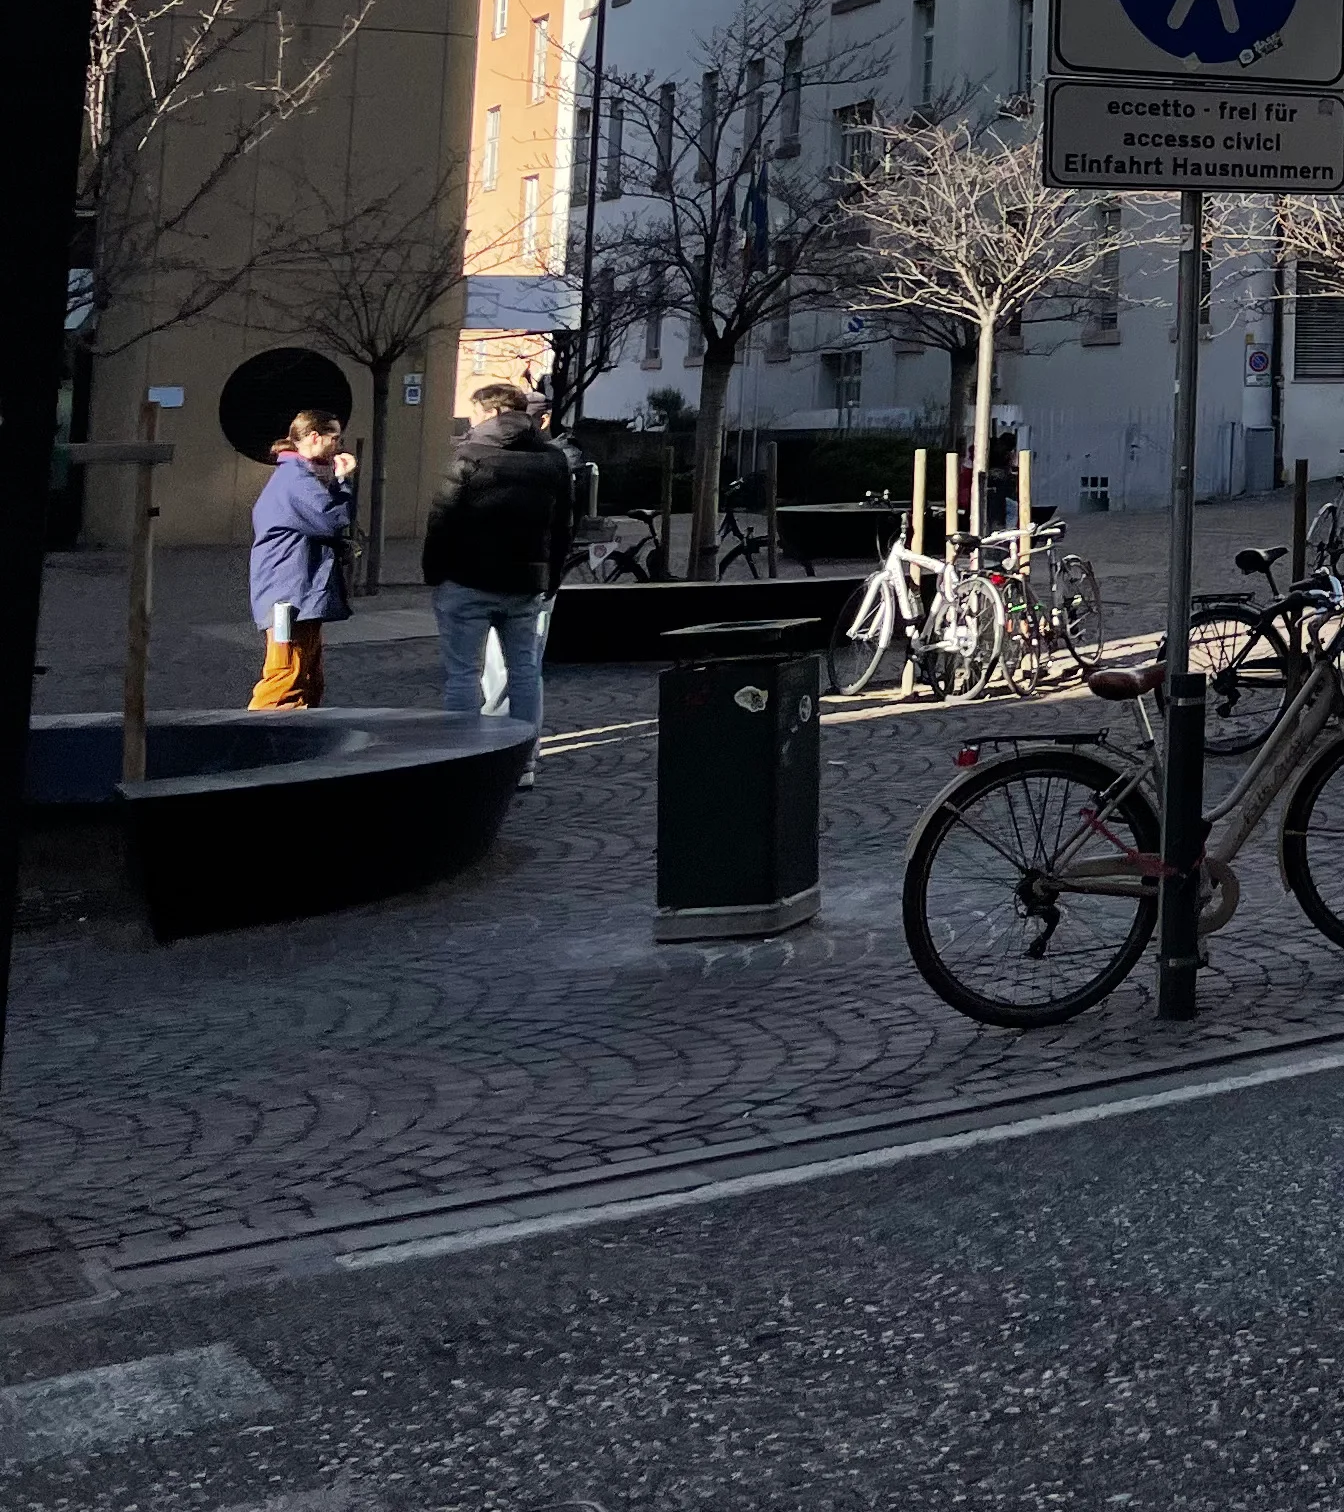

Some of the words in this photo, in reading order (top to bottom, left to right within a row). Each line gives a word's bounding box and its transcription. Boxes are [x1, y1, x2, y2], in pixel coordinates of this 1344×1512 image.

[1107, 99, 1196, 118] eccetto
[1218, 101, 1257, 121] frei
[1265, 102, 1298, 123] für
[1123, 132, 1216, 149] accesso
[1223, 132, 1282, 152] civici
[1064, 153, 1164, 175] Einfahrt
[1172, 157, 1334, 180] Hausnummern
